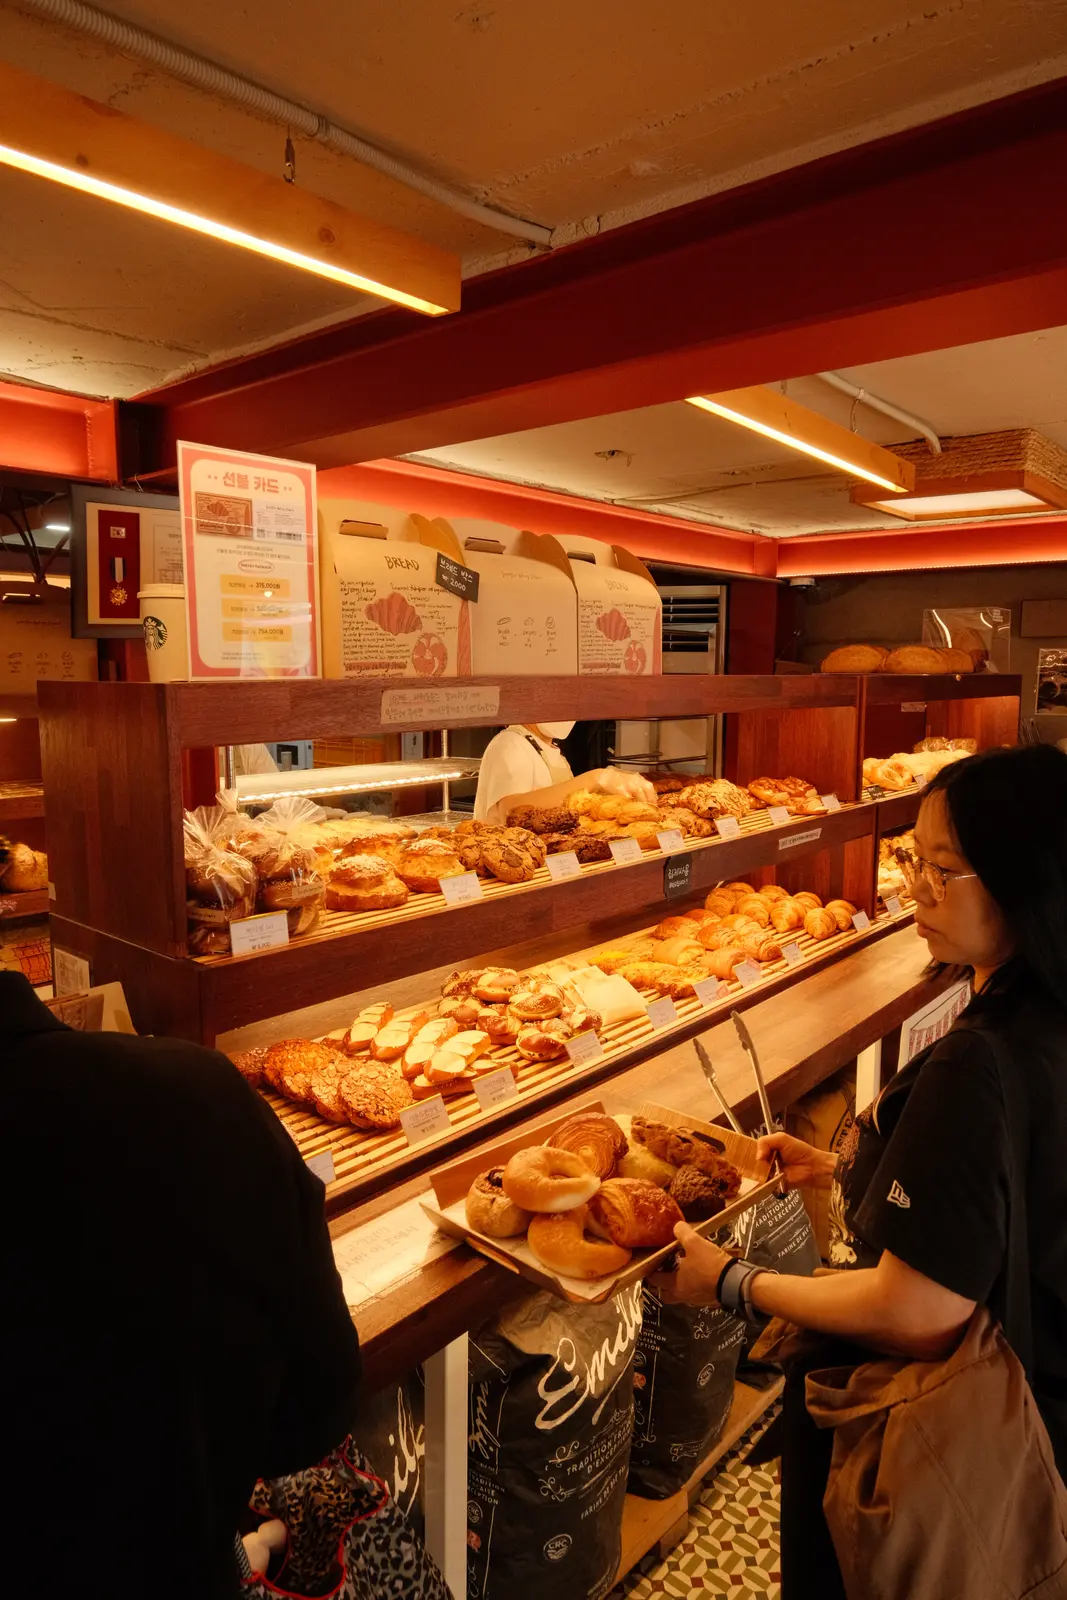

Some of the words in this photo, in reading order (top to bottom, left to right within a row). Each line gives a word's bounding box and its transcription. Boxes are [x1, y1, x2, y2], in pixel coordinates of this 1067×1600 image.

[223, 471, 249, 490] 선불
[254, 476, 280, 494] 카드
[384, 555, 420, 571] BREAD
[440, 558, 458, 576] 브레드
[460, 570, 474, 583] 박스
[450, 581, 467, 592] 2000
[567, 1438, 613, 1476] TRADITION
[580, 1497, 602, 1520] FARINE
